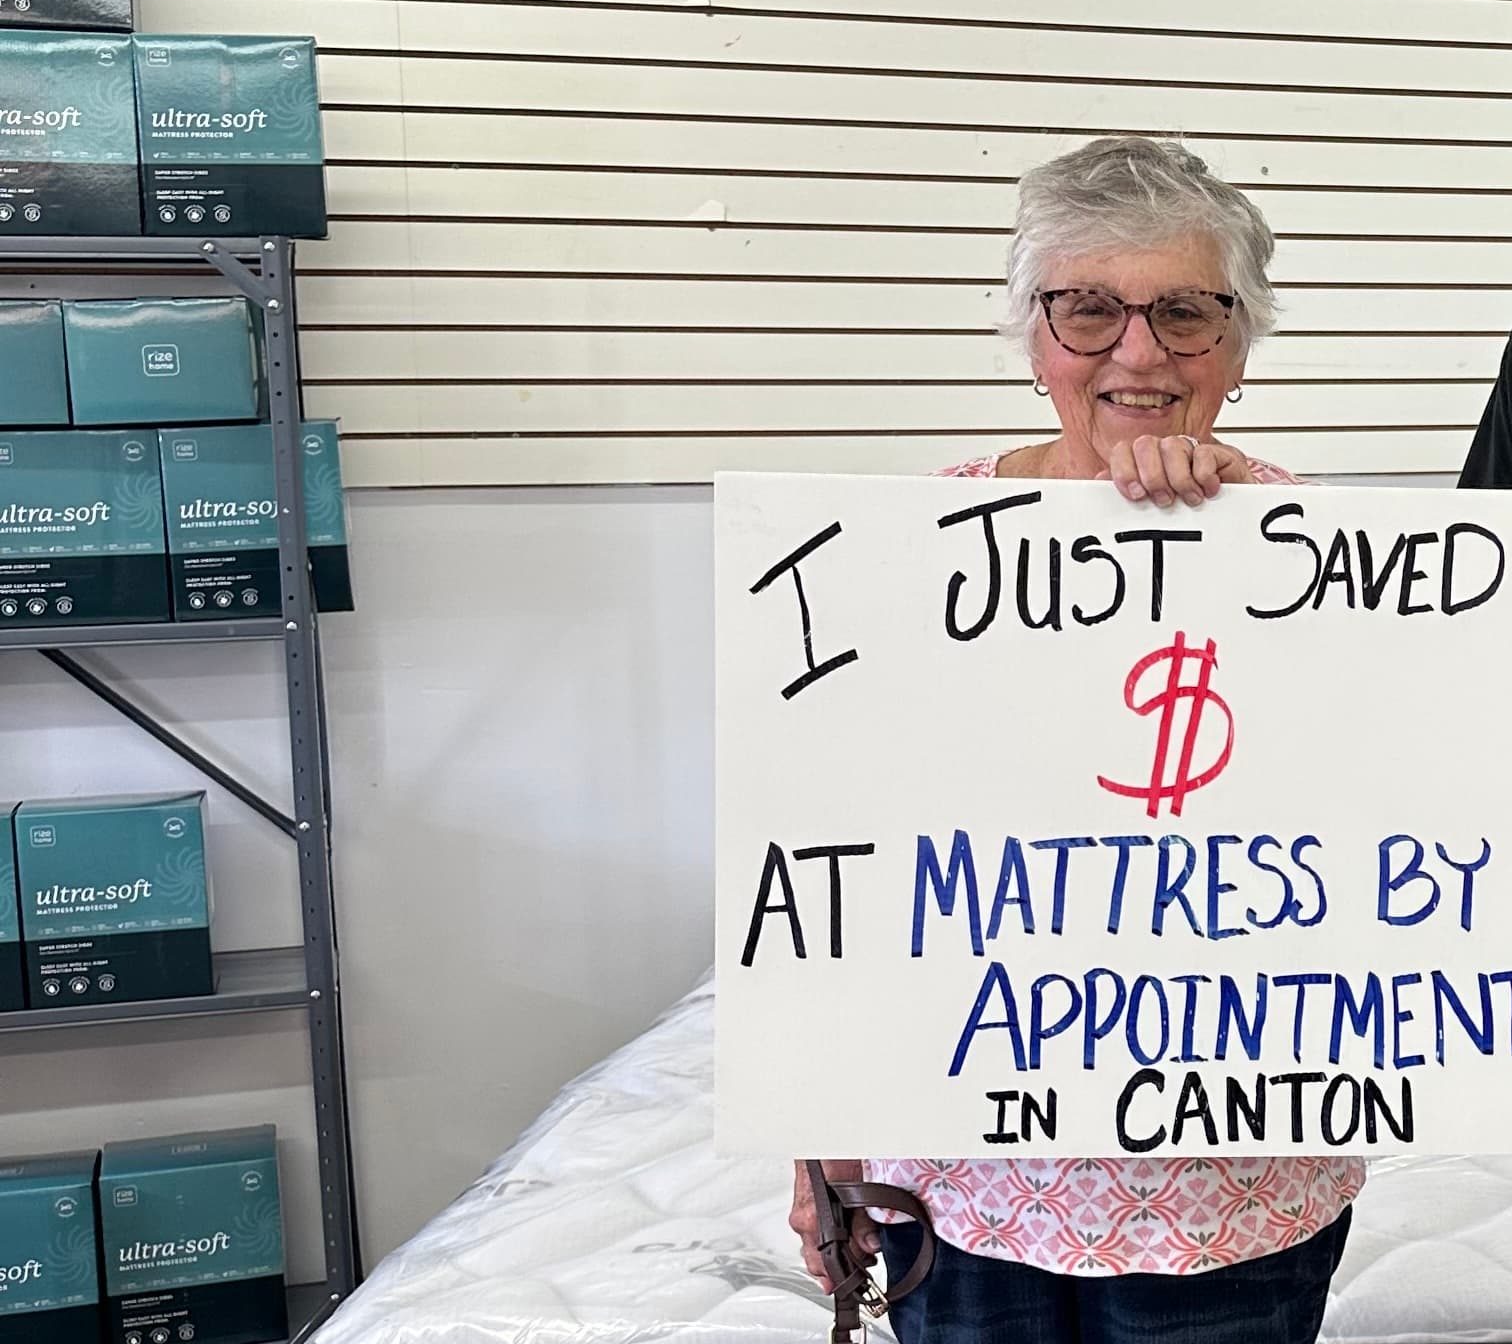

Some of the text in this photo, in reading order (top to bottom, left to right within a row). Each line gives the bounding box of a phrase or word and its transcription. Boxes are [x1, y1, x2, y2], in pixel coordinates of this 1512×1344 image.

[152, 108, 268, 132] ultra-soft
[148, 350, 173, 362] rize
[180, 499, 278, 519] ultra-so
[749, 490, 1505, 700] I JUST SAVED
[1097, 631, 1235, 818] $
[36, 878, 152, 905] ultra-soft
[740, 829, 1491, 967] AT MATTRESS BY
[983, 1070, 1414, 1152] IN CANTON
[119, 1231, 230, 1261] ultra-soft
